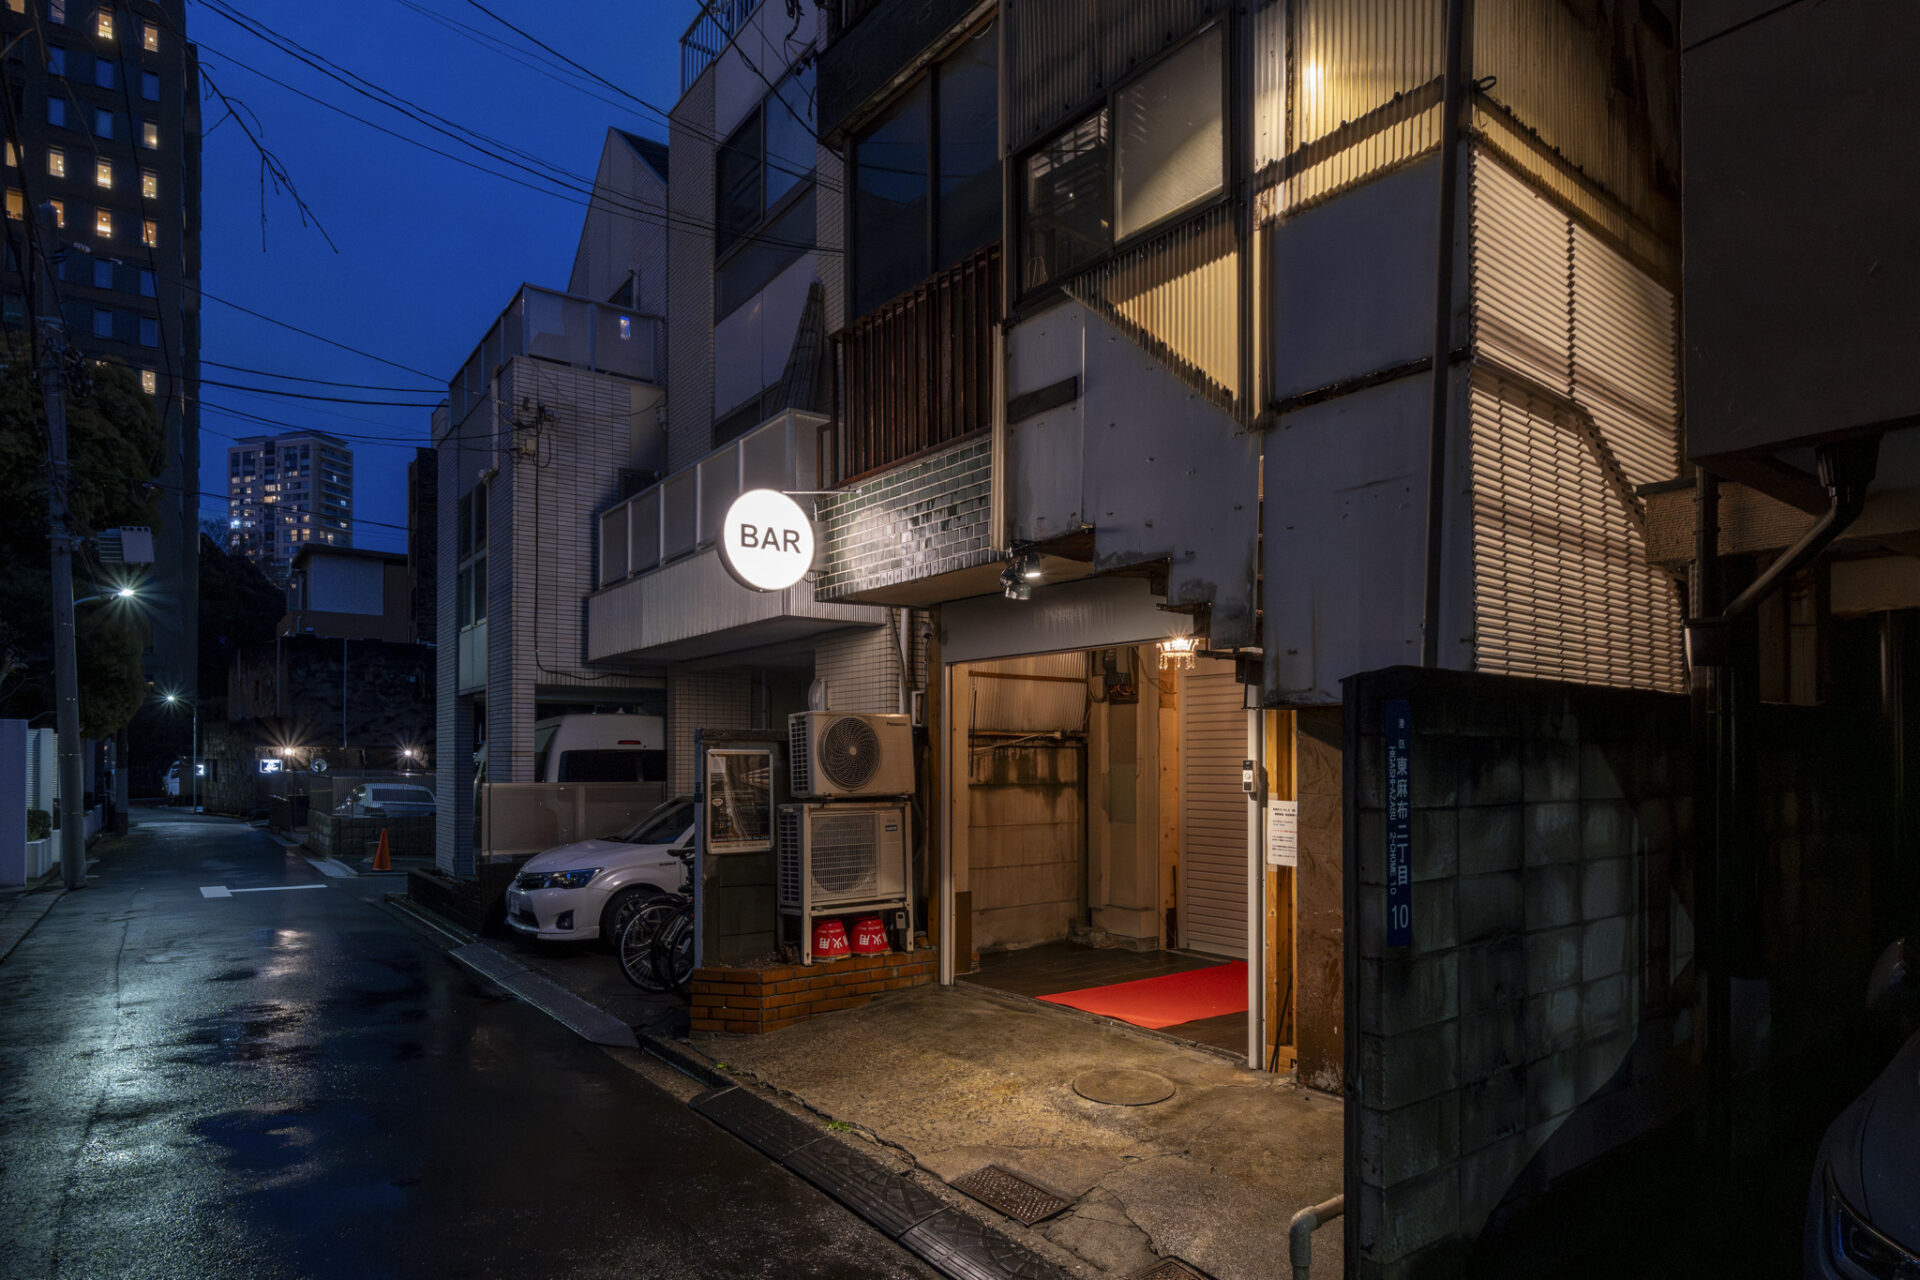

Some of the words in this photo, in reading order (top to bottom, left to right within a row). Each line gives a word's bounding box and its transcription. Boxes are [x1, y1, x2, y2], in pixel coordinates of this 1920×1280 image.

[741, 523, 801, 554] BAR
[1388, 745, 1396, 821] HIGASHI-AZABU
[1397, 755, 1409, 885] 東麻布二丁目
[1389, 832, 1397, 877] 2-CHOME
[1391, 903, 1409, 931] 10
